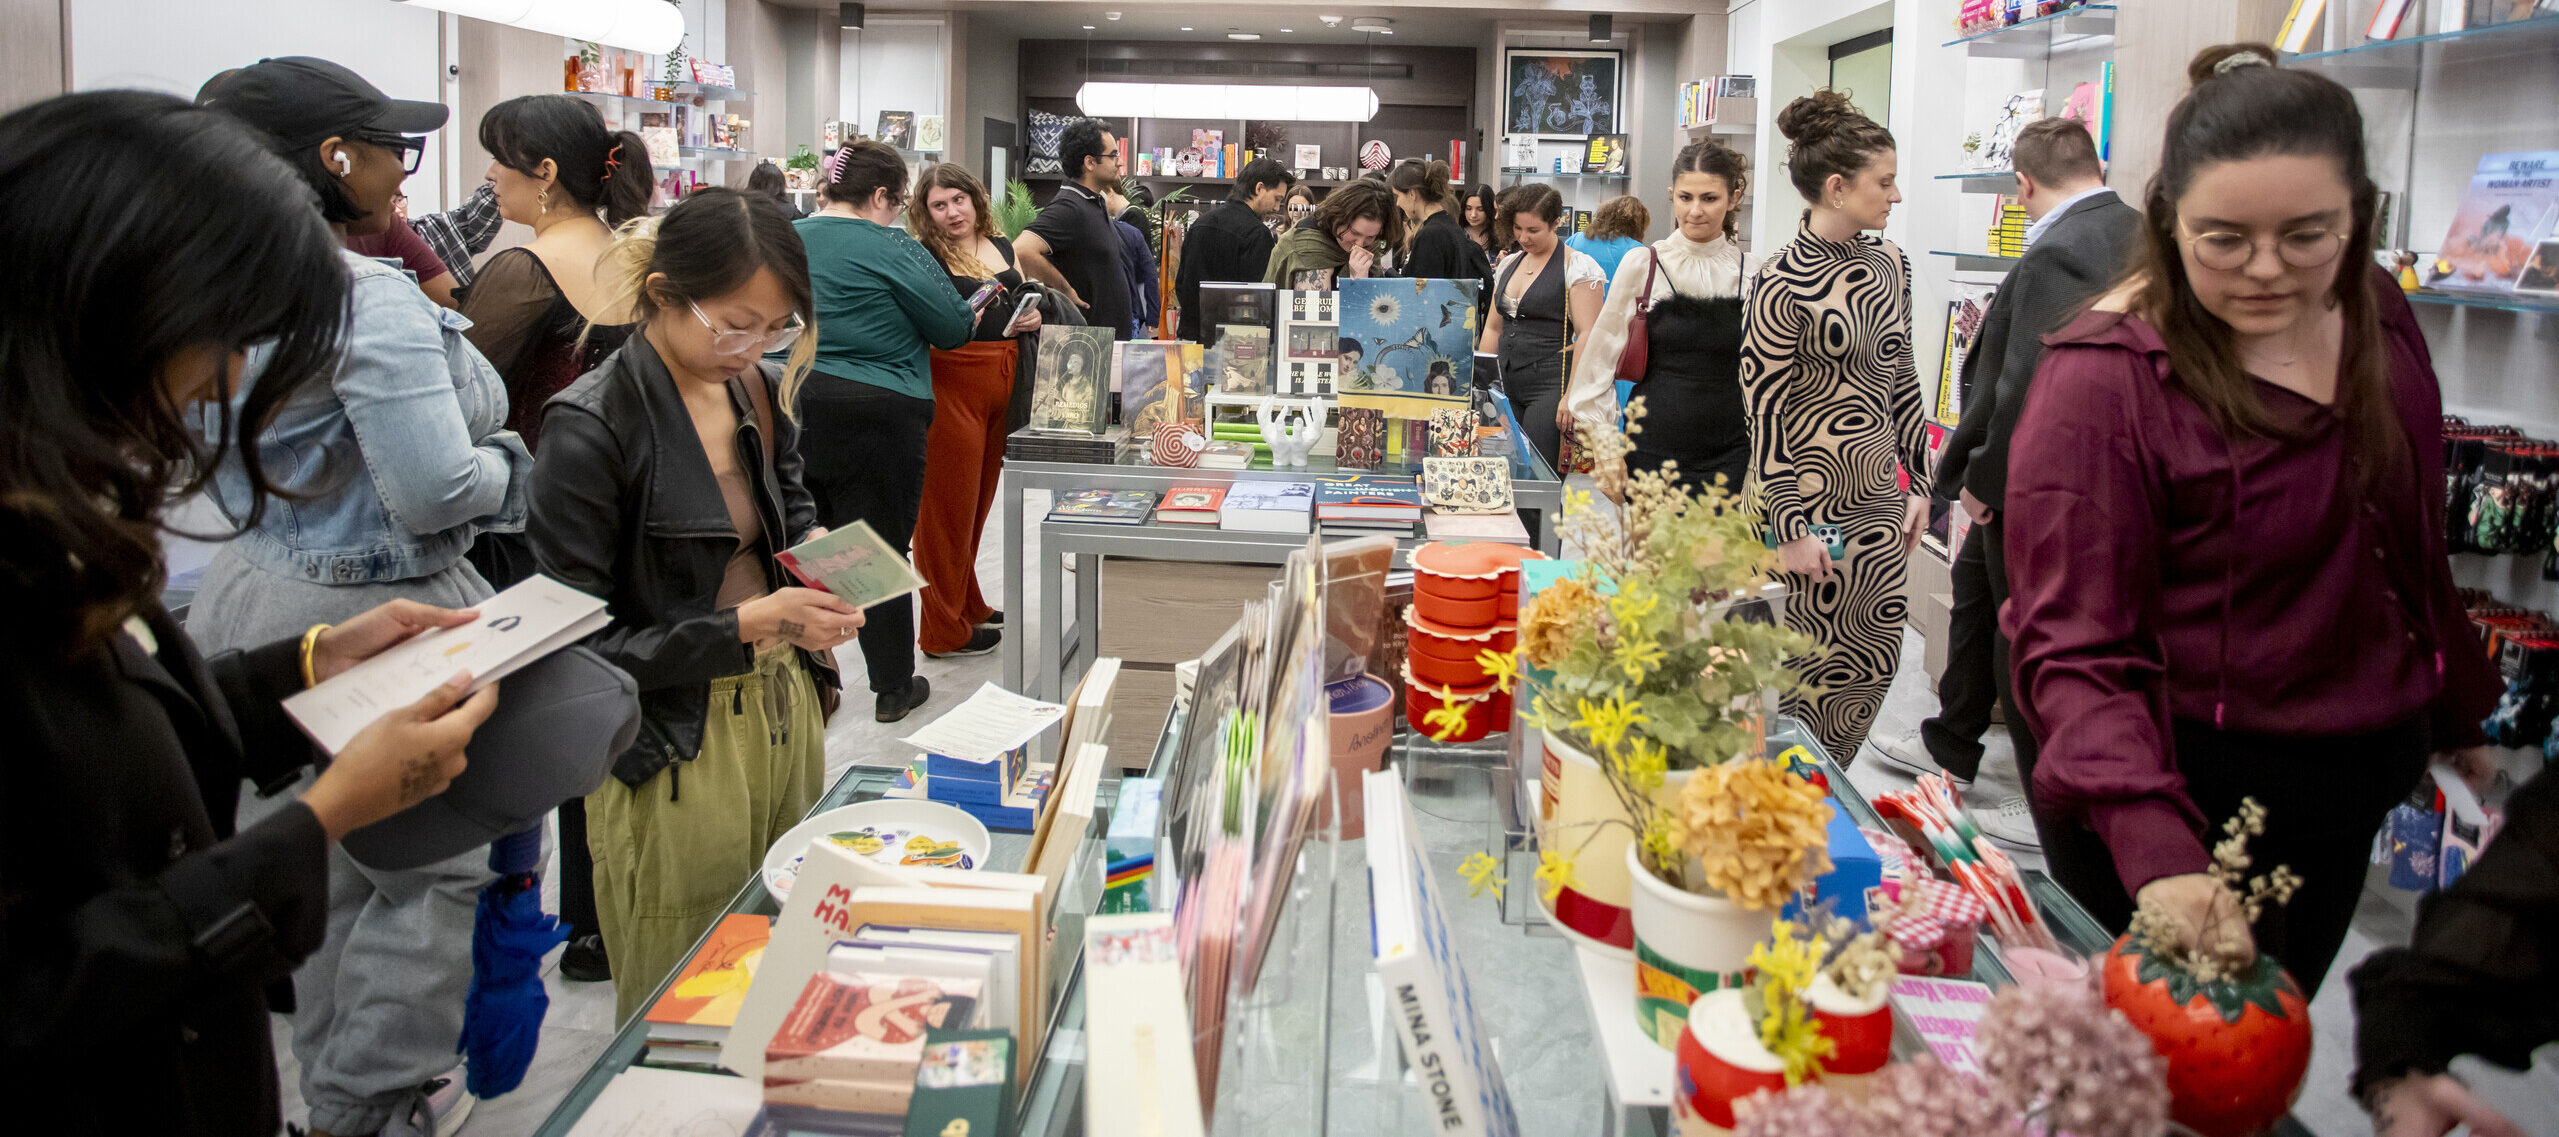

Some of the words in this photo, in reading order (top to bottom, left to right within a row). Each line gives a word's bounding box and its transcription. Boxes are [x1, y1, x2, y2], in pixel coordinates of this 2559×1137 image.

[2509, 160, 2547, 171] BEWARE
[2487, 180, 2520, 189] WOMAN
[2520, 178, 2552, 188] ARTIST
[1055, 401, 1088, 410] REMEDIOS
[1396, 983, 1432, 1048] MINA
[1420, 1050, 1464, 1131] STONE
